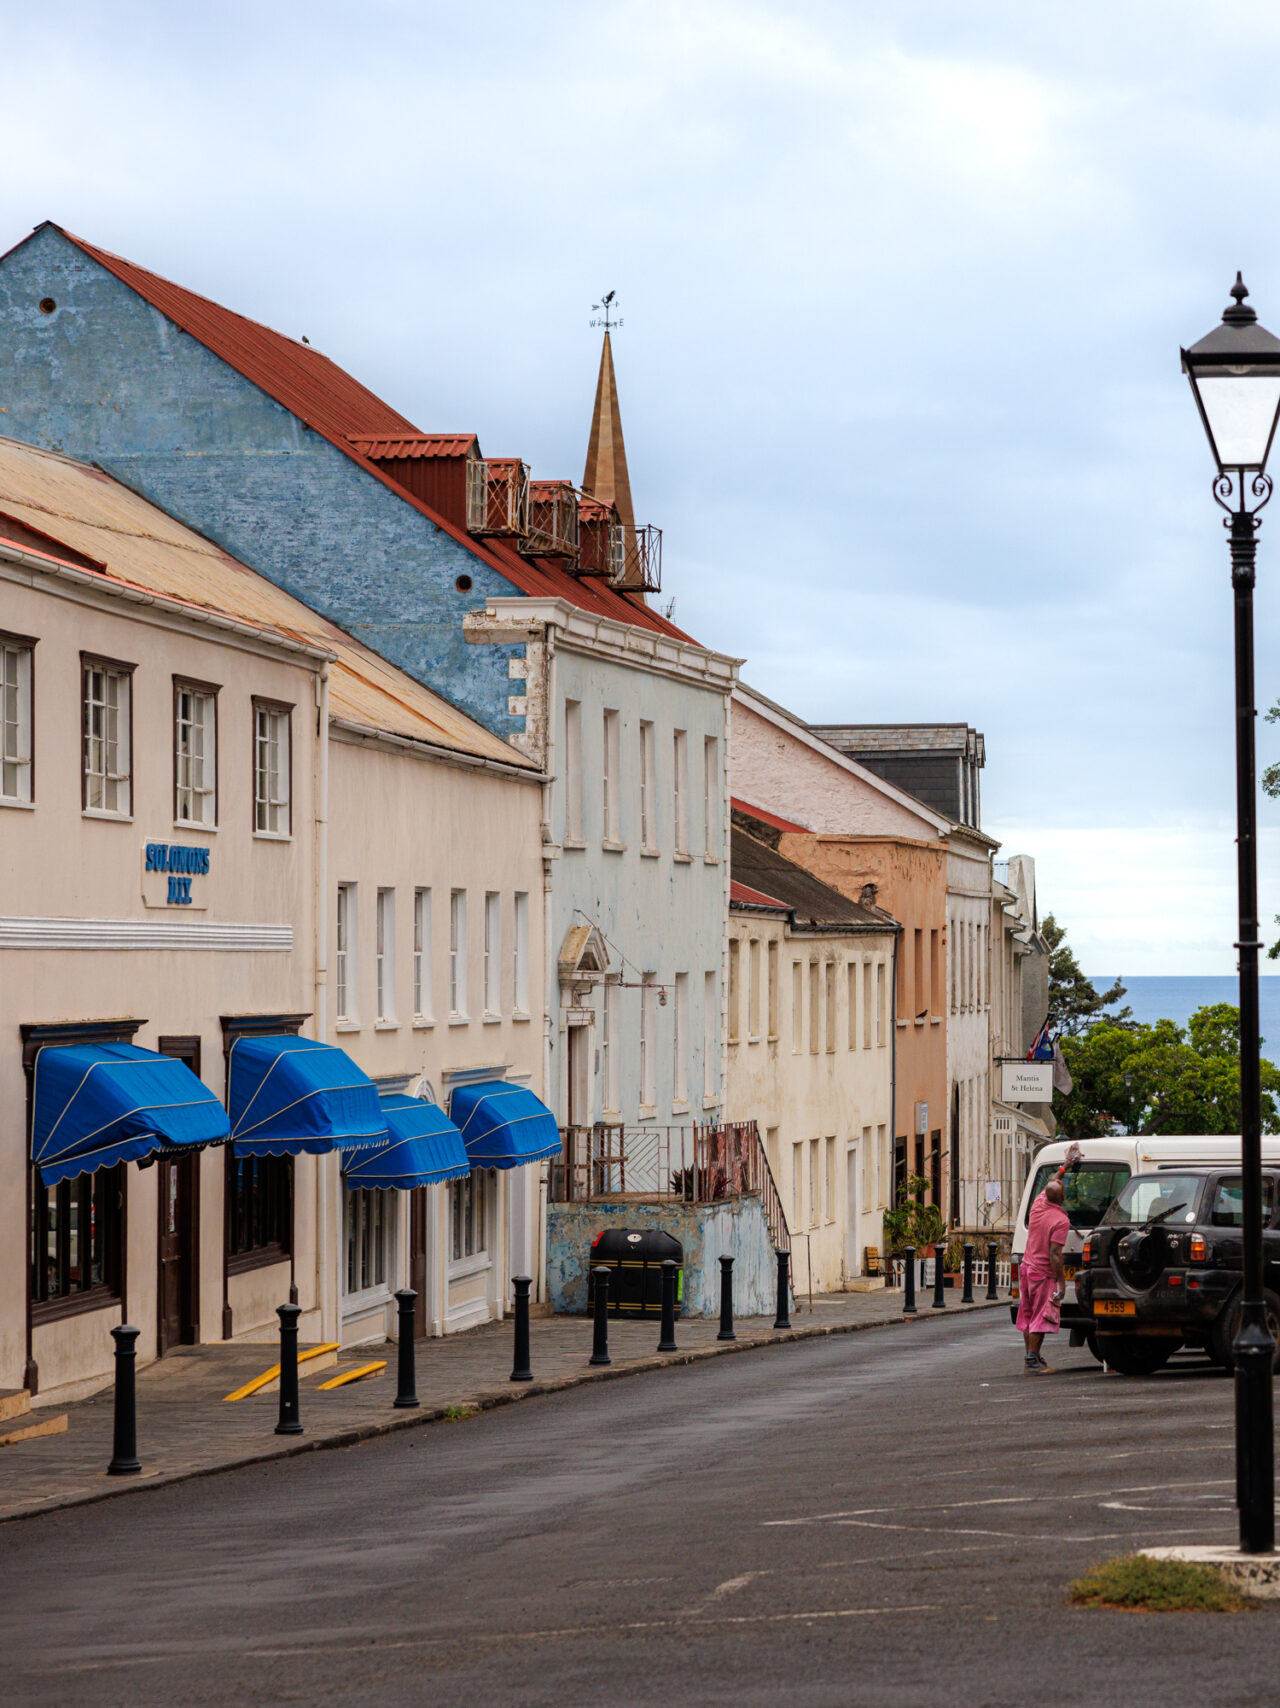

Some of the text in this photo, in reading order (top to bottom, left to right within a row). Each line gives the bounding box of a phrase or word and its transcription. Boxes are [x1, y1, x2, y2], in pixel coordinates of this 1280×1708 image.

[619, 318, 625, 327] E
[145, 843, 210, 875] SOLOMONS
[167, 876, 193, 904] DIY
[1015, 1074, 1040, 1082] Mantis
[1011, 1084, 1043, 1092] St Helena
[1104, 1300, 1124, 1313] 4359
